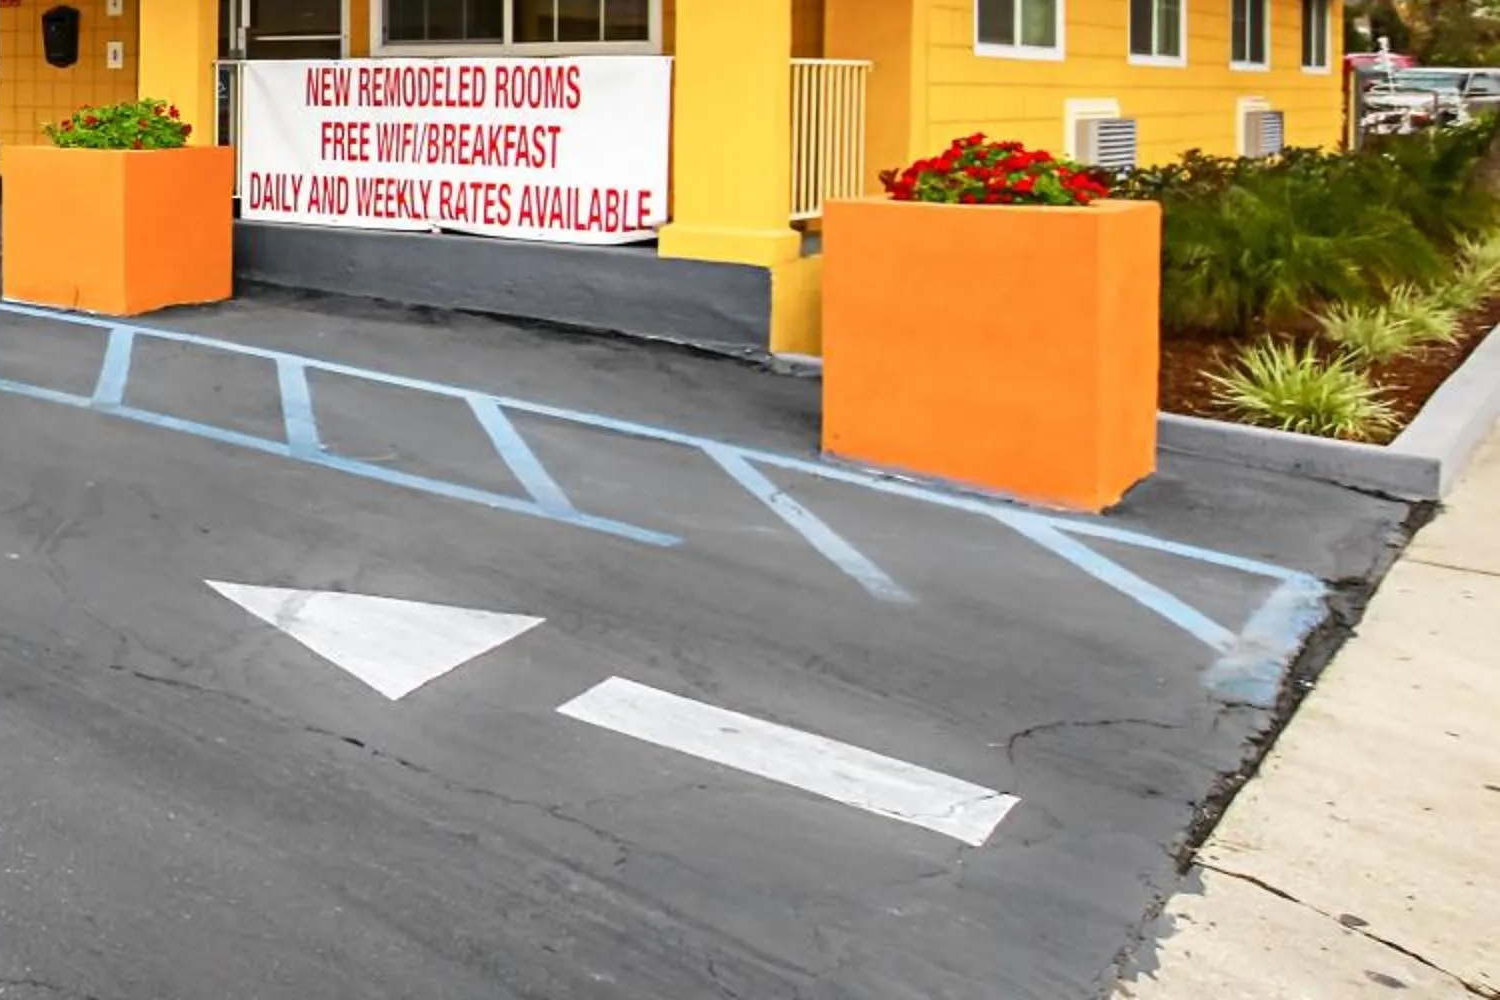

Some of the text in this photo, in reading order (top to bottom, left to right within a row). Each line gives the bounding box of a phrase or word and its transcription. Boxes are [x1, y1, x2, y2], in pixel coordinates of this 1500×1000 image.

[306, 65, 581, 109] NEW REMODELED ROOMS
[321, 121, 561, 169] FREE WIFI/BREAKFAST
[250, 171, 653, 233] DAILY AND WEEKLY RATES AVAILABLE
